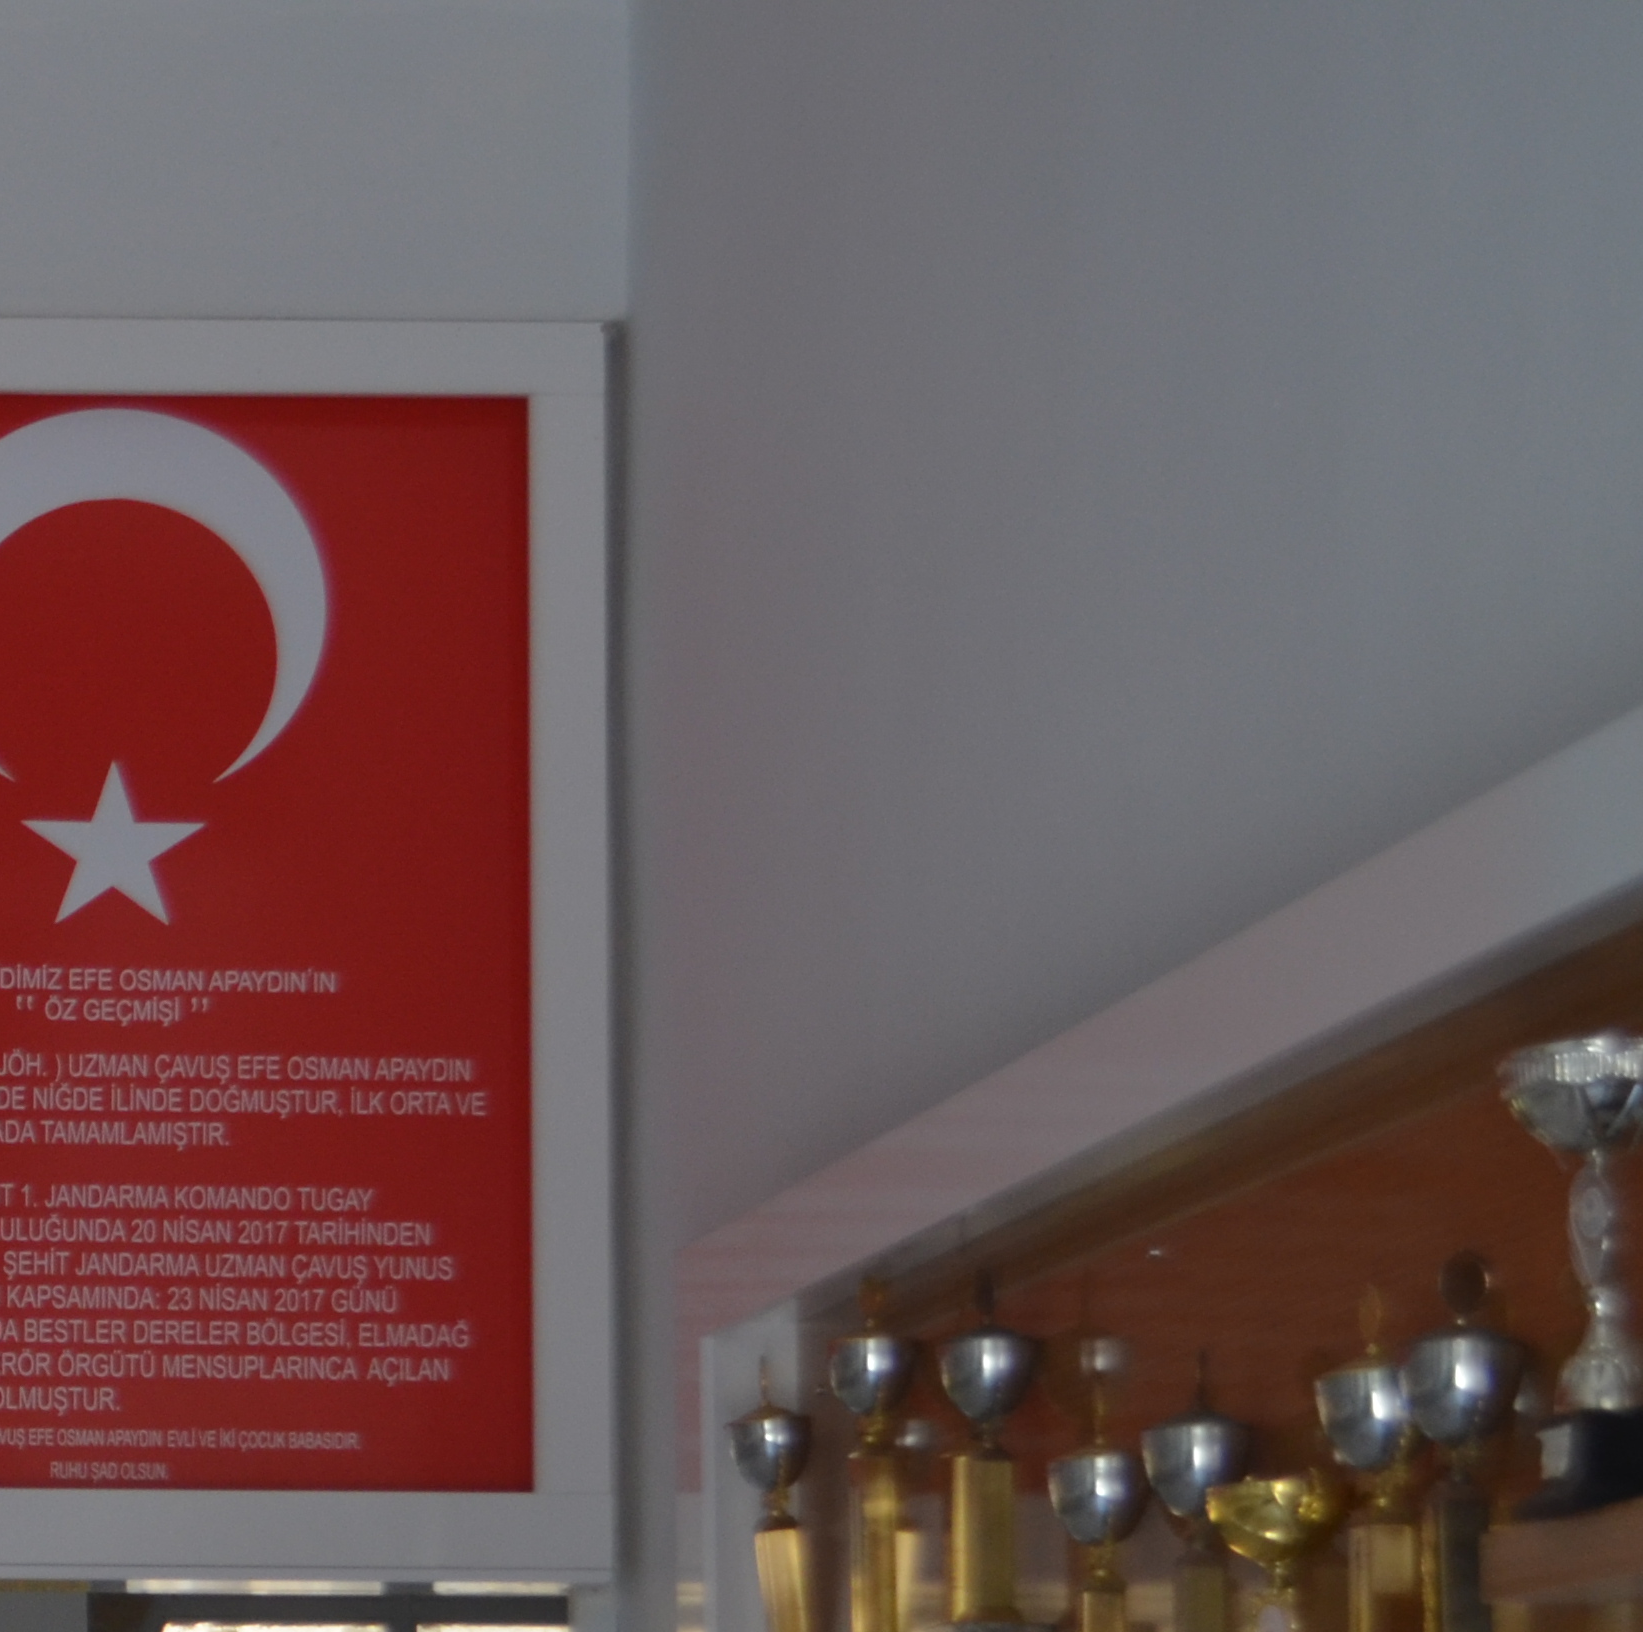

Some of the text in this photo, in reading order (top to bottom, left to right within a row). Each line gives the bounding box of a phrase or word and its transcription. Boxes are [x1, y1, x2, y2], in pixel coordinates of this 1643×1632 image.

[69, 967, 114, 993] EFE
[120, 968, 207, 993] OSMAN
[45, 994, 182, 1029] ÖZ GEÇMİŞİ
[33, 1082, 106, 1114] NİĞDE
[111, 1083, 184, 1115] İLİNDE
[190, 1084, 344, 1121] DOĞMUŞTUR,
[351, 1086, 385, 1117] İLK
[390, 1090, 451, 1118] ORTA
[454, 1091, 488, 1119] VE
[41, 1120, 231, 1153] TAMAMLAMIŞTIR.
[22, 1184, 38, 1210] 1.
[45, 1183, 171, 1211] JANDARMA
[174, 1185, 293, 1213] KOMANDO
[297, 1187, 374, 1214] TUGAY
[131, 1218, 159, 1245] 20
[163, 1215, 234, 1246] NİSAN
[238, 1220, 291, 1246] 2017
[294, 1218, 433, 1249] TARİHİNDEN
[7, 1284, 161, 1312] KAPSAMINDA:
[168, 1286, 196, 1313] 23
[199, 1283, 271, 1313] NİSAN
[275, 1288, 327, 1314] 2017
[332, 1288, 399, 1316] GÜNÜ
[24, 1318, 129, 1346] BESTLER
[134, 1319, 242, 1347] DERELER
[247, 1318, 352, 1349] BÖLGESİ,
[359, 1320, 470, 1350] ELMADAĞ
